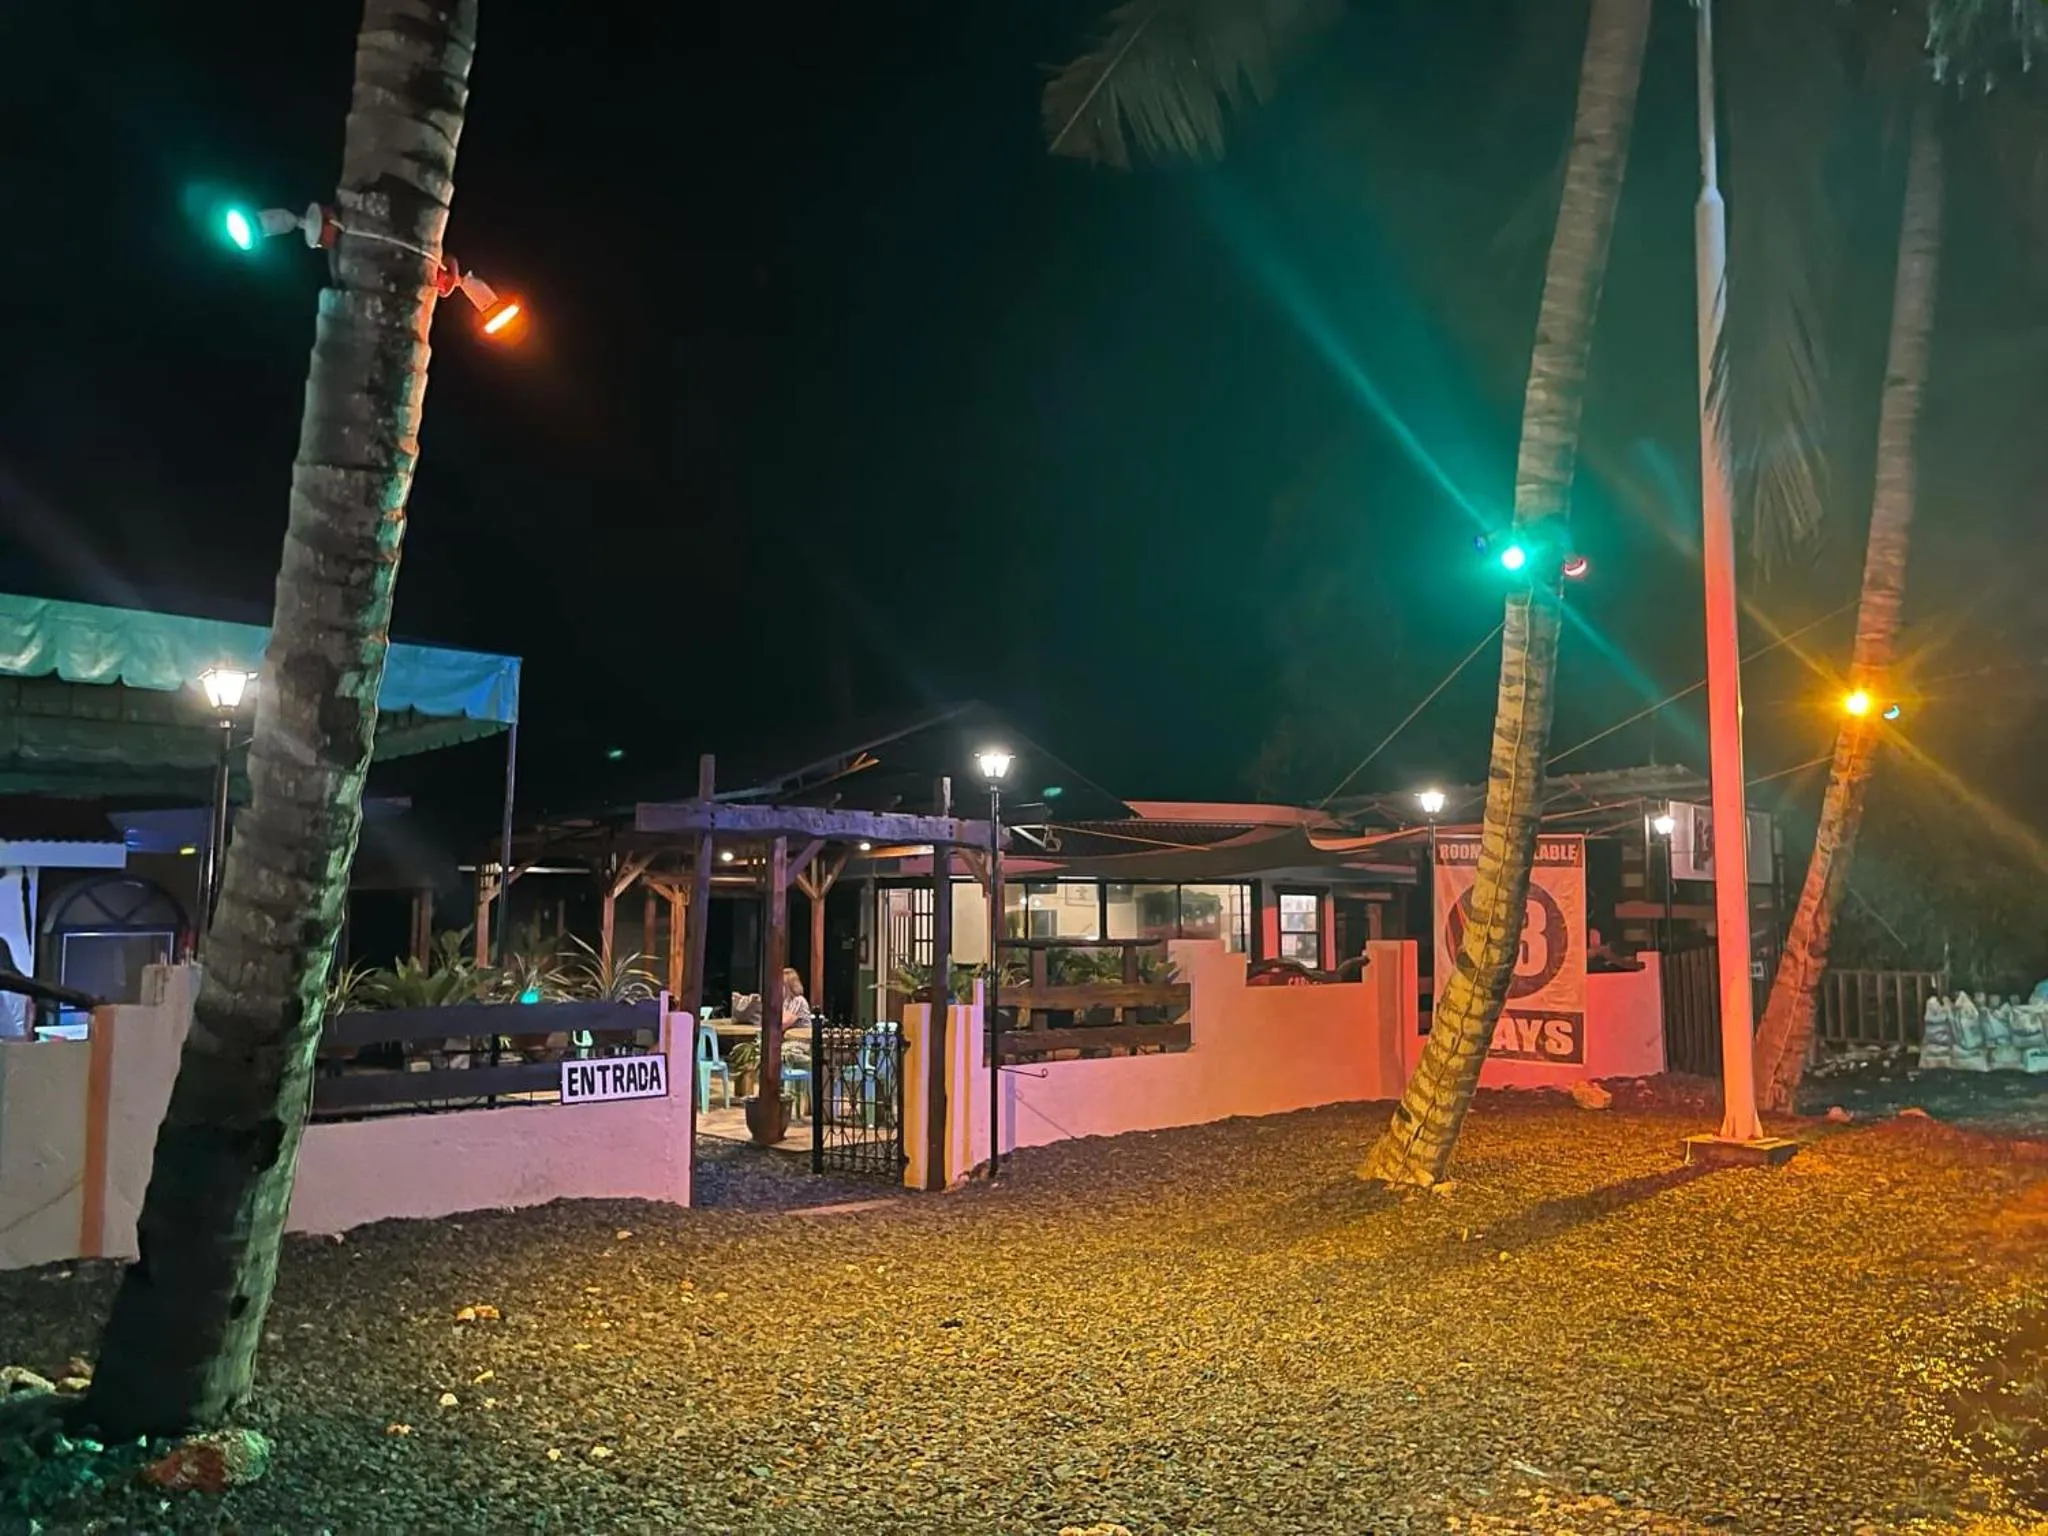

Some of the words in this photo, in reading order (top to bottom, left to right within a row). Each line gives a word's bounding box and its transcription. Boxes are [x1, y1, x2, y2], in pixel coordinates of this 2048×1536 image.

[1439, 843, 1482, 860] ROOM
[1489, 1017, 1574, 1056] AYS
[567, 1060, 662, 1097] ENTRADA
